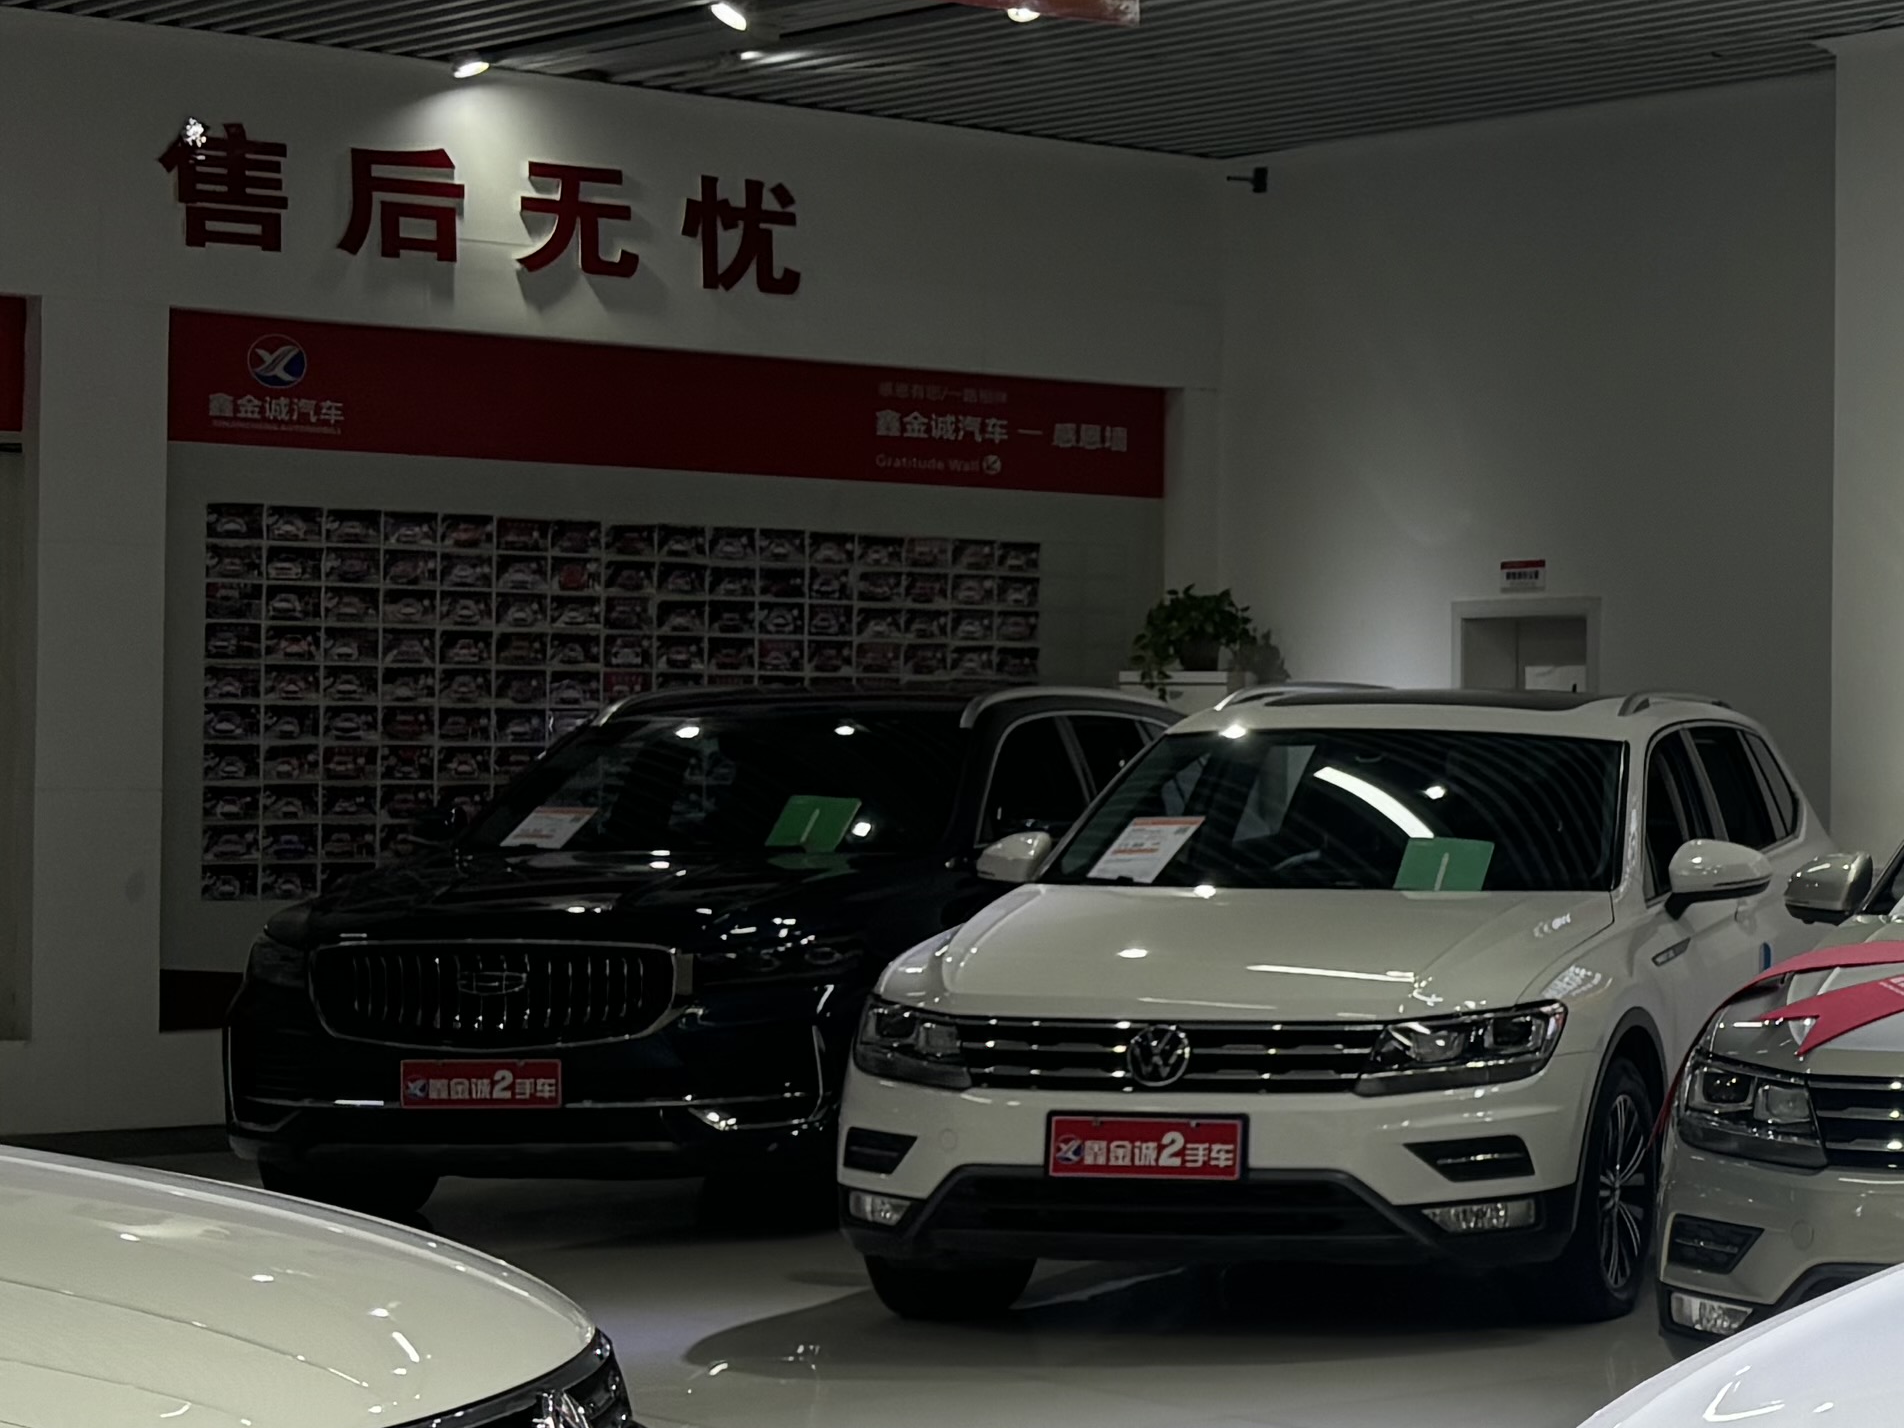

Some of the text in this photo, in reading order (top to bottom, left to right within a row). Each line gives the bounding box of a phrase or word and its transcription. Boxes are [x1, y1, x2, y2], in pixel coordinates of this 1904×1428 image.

[156, 123, 800, 295] 售后无忧
[209, 393, 344, 424] 鑫金诚汽车
[428, 1068, 556, 1100] 鑫金诚2手车
[1083, 1130, 1234, 1169] 鑫金诚2手车
